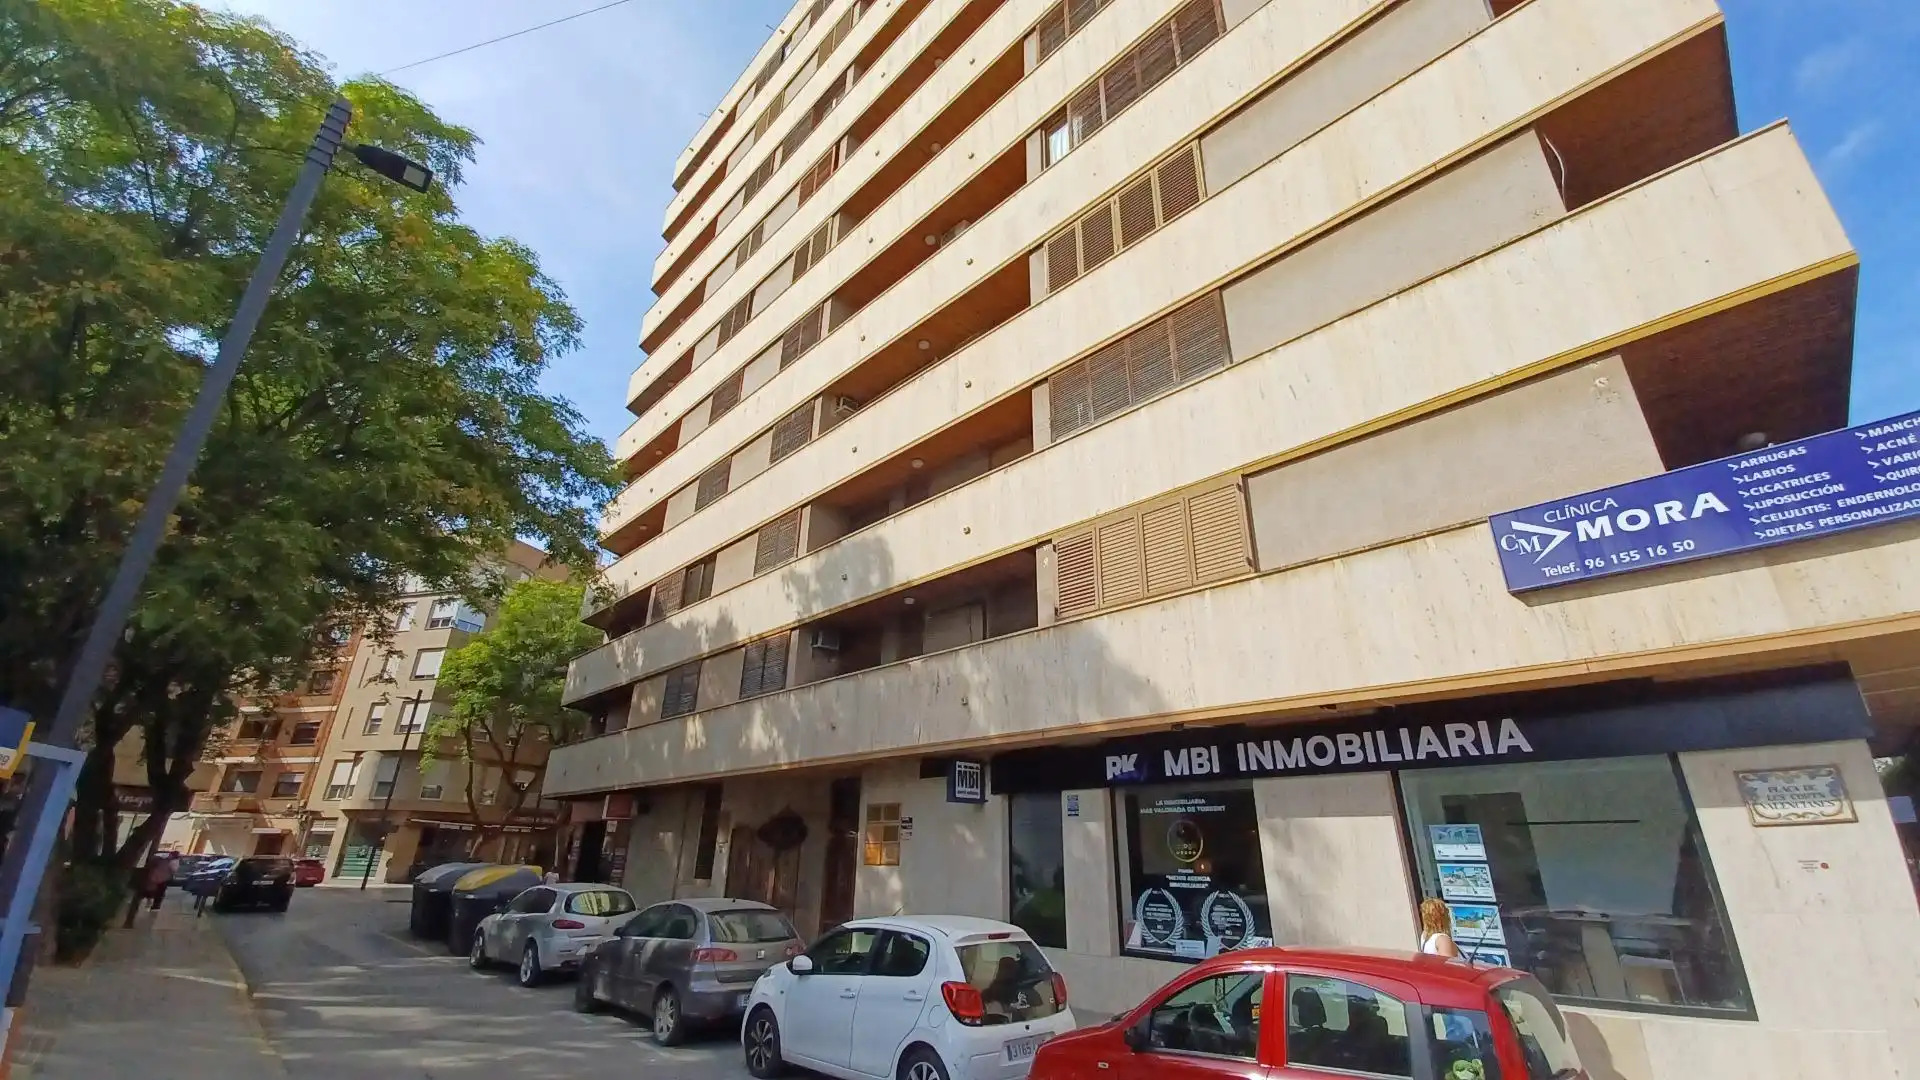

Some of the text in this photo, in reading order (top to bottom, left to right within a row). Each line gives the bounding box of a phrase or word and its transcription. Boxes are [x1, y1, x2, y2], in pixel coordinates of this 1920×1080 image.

[1876, 433, 1917, 451] ACNÉ
[1740, 446, 1807, 468] ARRUGAS
[1881, 450, 1920, 466] VARI
[1743, 464, 1796, 482] LABIOS
[1749, 471, 1831, 496] CICATRICES
[1886, 466, 1920, 480] QUIR
[1754, 483, 1845, 509] LIPOSUCCIÓN
[1543, 497, 1619, 523] CLÍNICA
[1575, 491, 1729, 542] MORA
[1760, 503, 1832, 523] CELULITIS:
[1765, 521, 1815, 537] DIETAS
[1500, 533, 1543, 555] CM
[1541, 539, 1695, 578] Telef. 96 155 16 50
[1163, 745, 1220, 776] MBI
[1236, 718, 1534, 772] INMOBILIARIA
